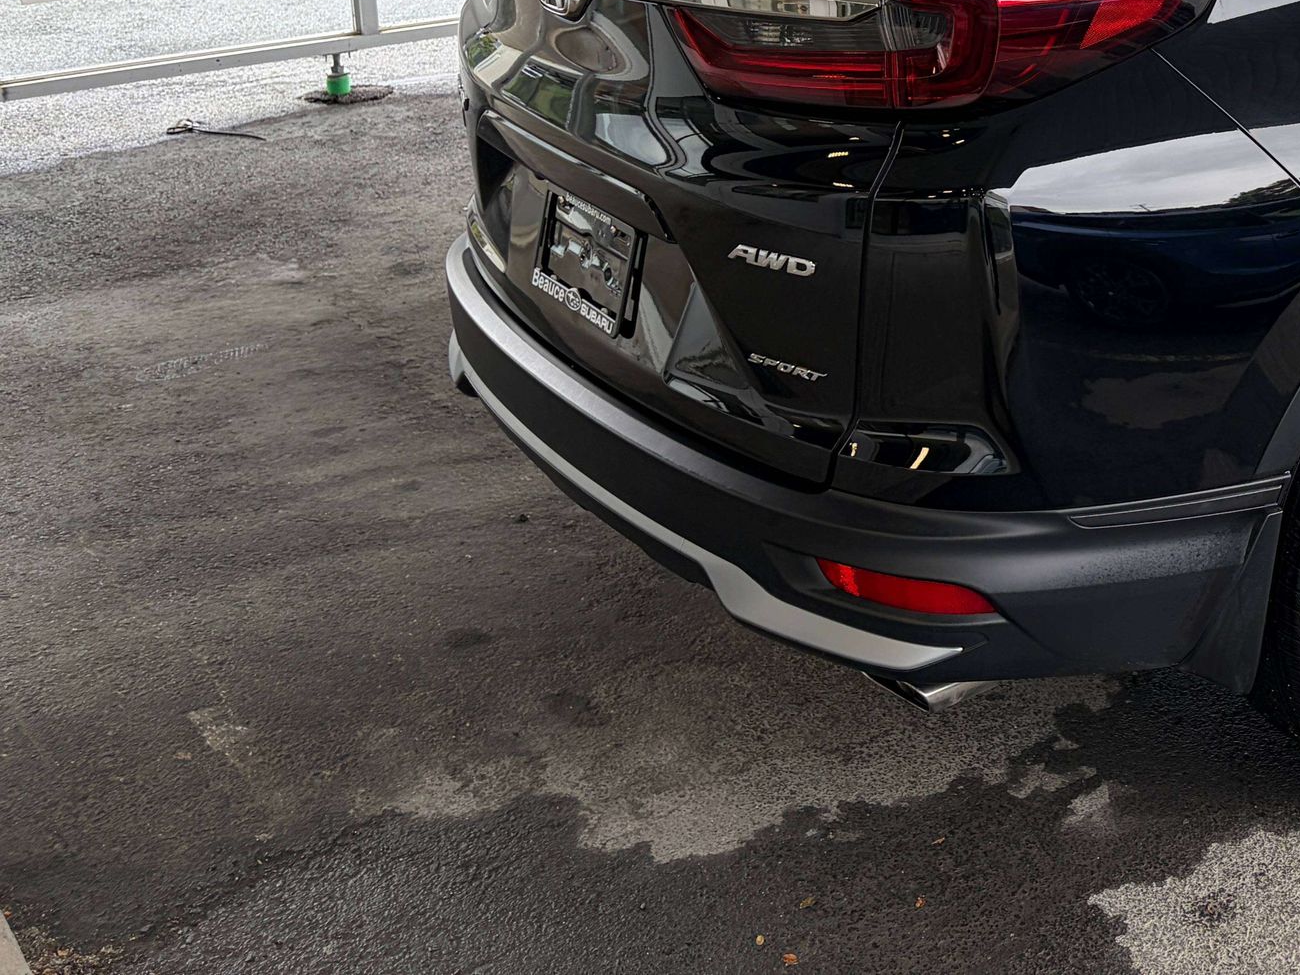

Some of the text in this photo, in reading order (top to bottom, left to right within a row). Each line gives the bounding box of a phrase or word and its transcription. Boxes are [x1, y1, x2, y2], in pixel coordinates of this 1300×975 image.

[728, 244, 816, 276] AWD
[531, 268, 613, 334] Beauce SUBARU
[747, 352, 828, 382] SPORT
